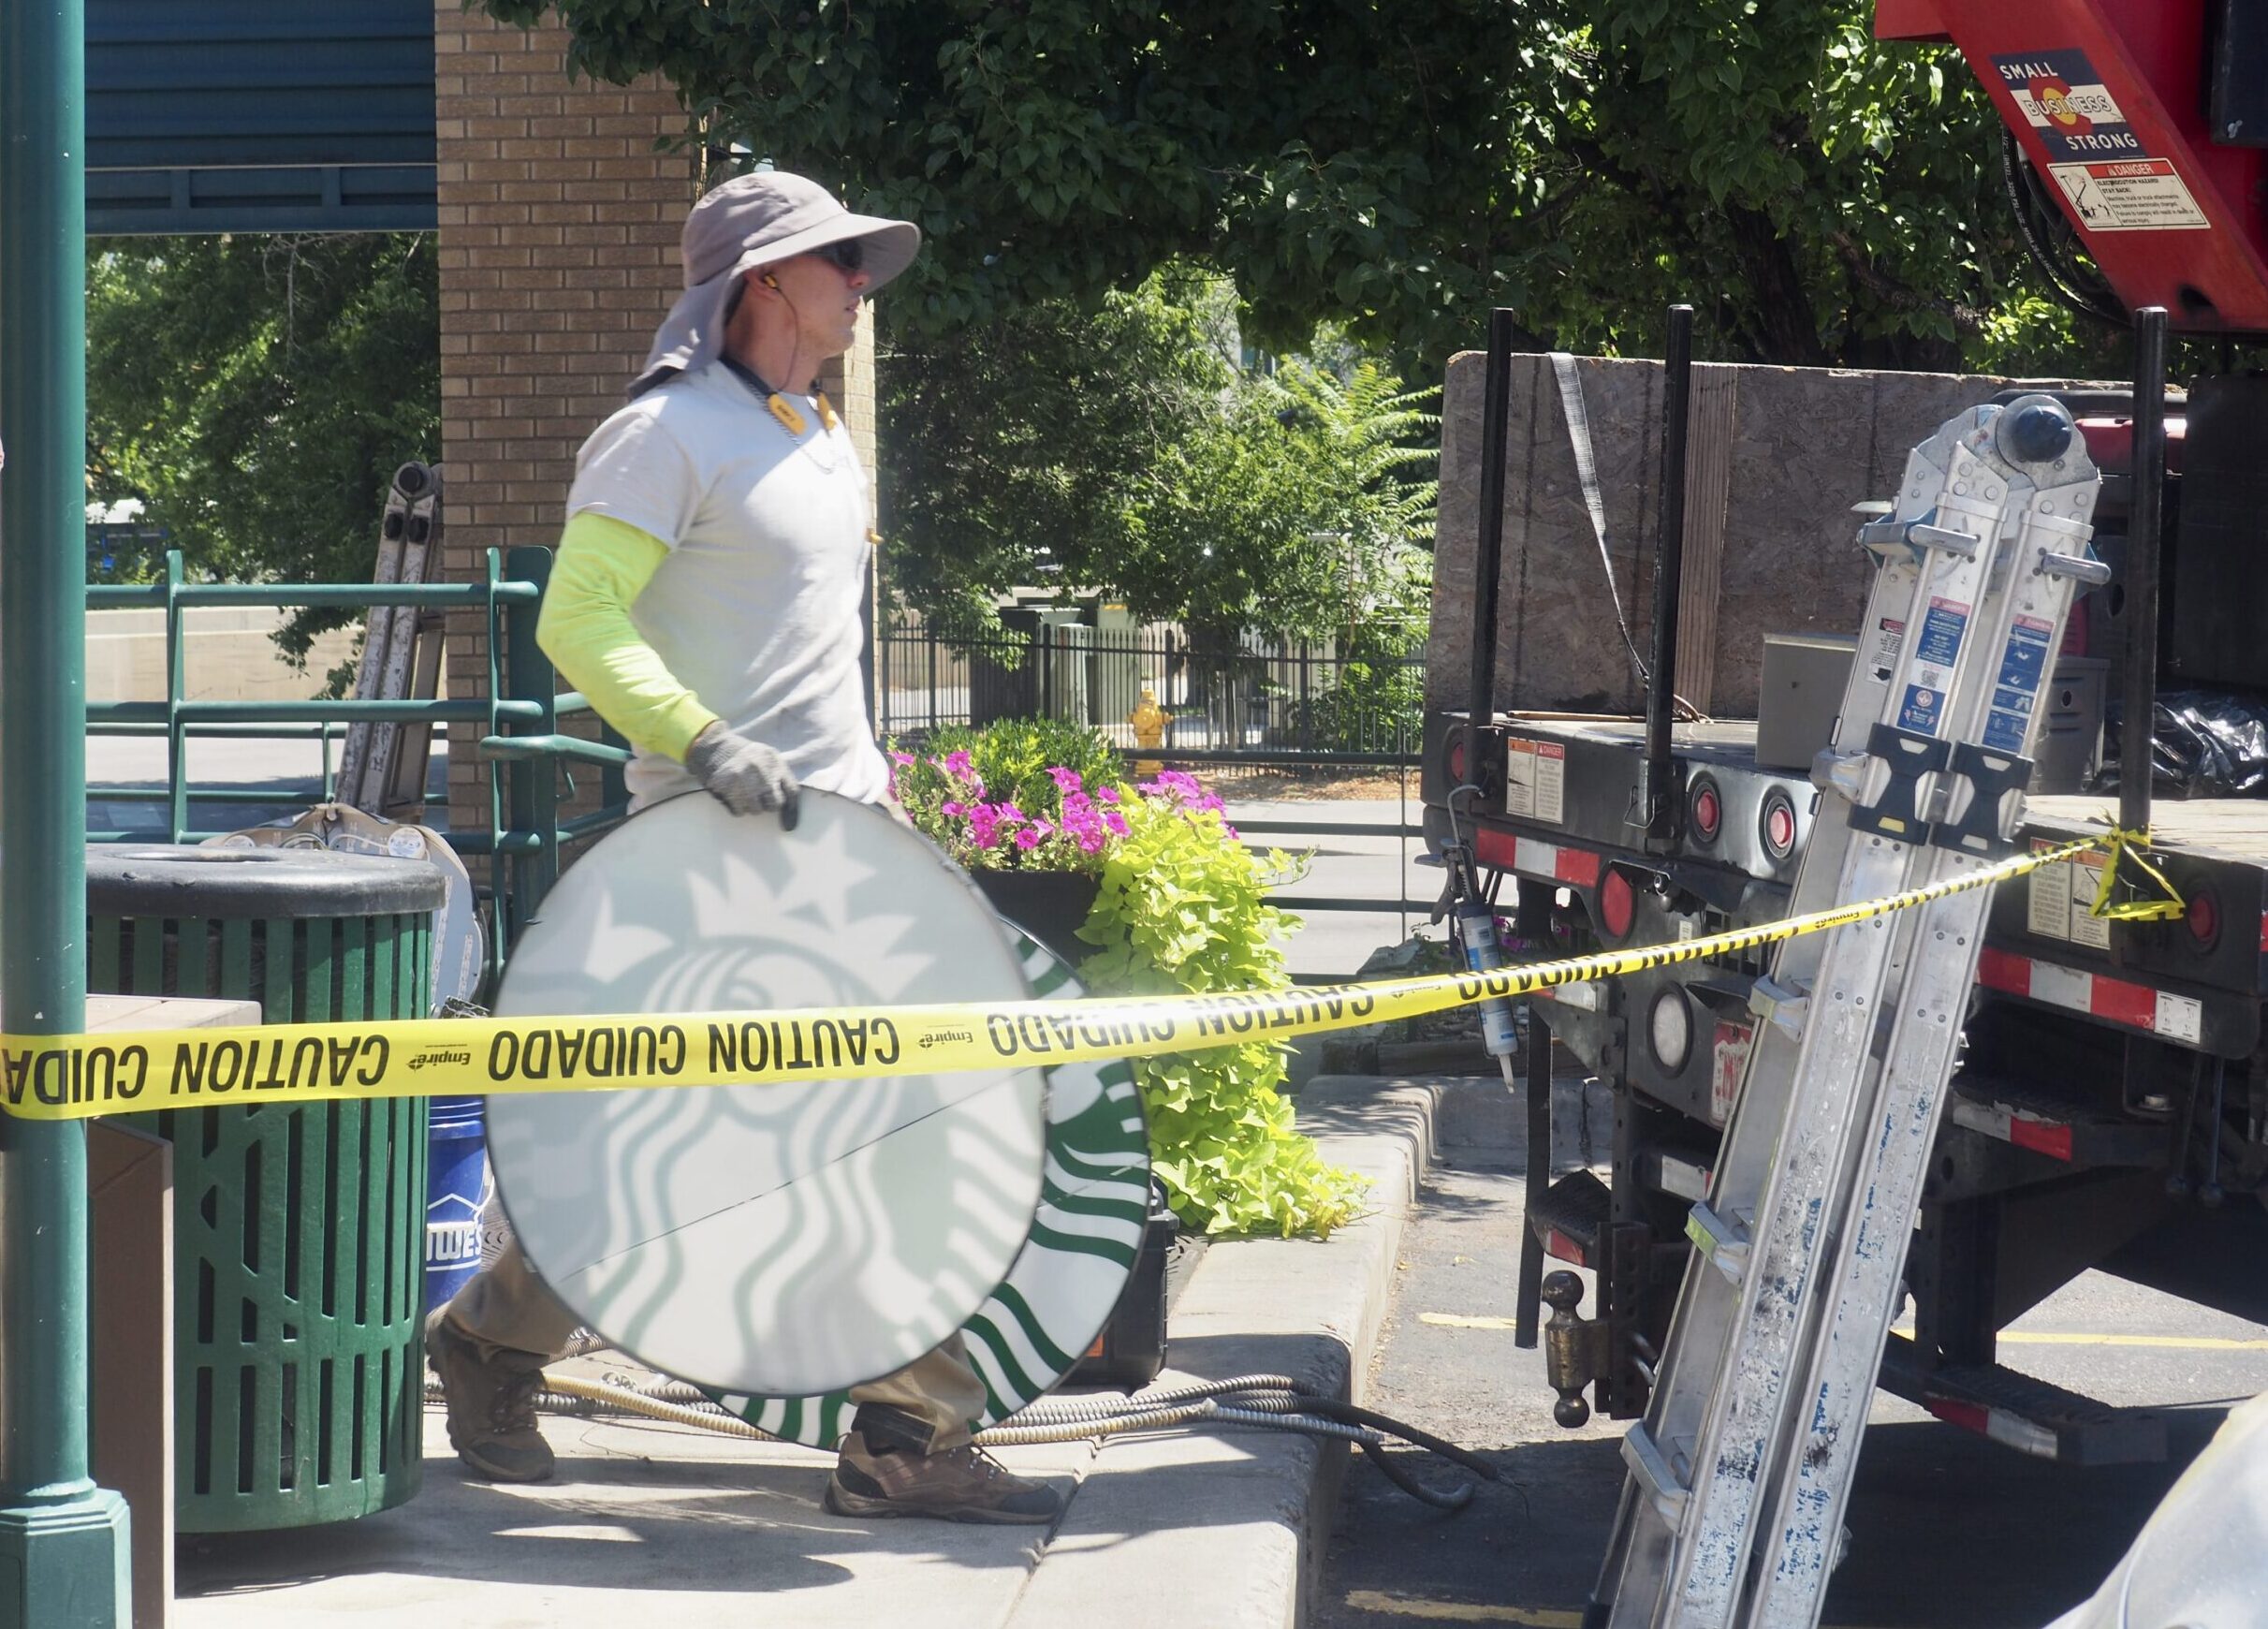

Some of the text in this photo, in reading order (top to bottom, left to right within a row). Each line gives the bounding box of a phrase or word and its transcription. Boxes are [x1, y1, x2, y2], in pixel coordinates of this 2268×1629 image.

[1998, 62, 2058, 81] SMALL
[2023, 95, 2112, 117] BUSINESS
[2065, 132, 2139, 151] STRONG
[2113, 163, 2155, 176] DANGER
[987, 983, 1375, 1057] CAUTION CUIDADO
[924, 1031, 973, 1046] Empire
[417, 1050, 471, 1066] Empire
[488, 1017, 900, 1082] CAUTION CUIDADO
[169, 1034, 389, 1095] CAUTION
